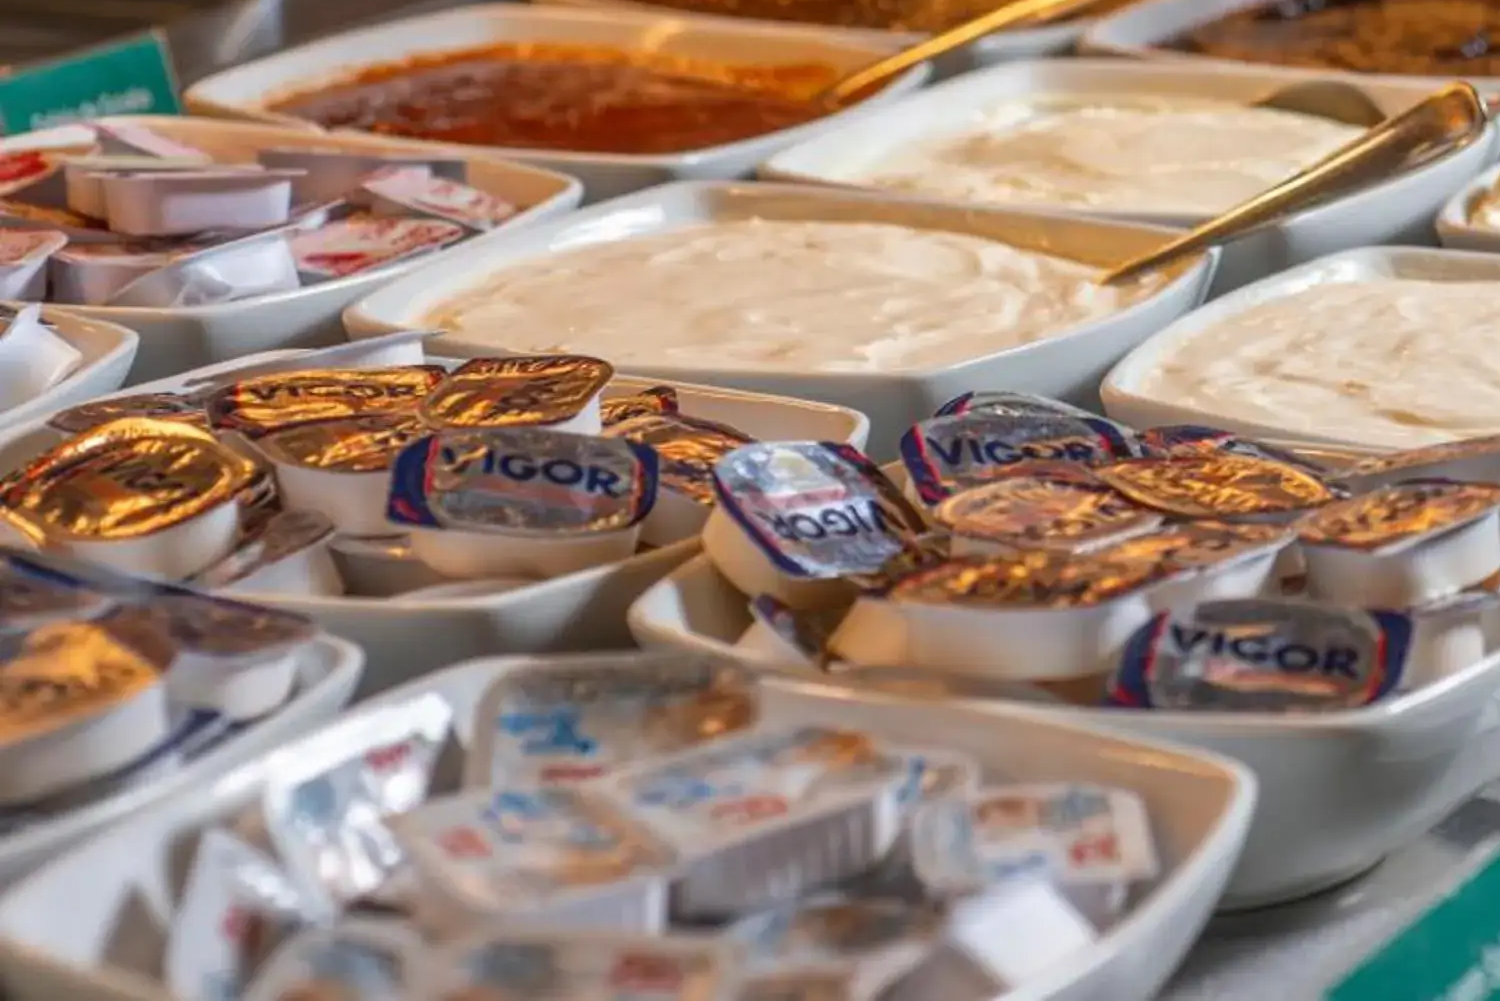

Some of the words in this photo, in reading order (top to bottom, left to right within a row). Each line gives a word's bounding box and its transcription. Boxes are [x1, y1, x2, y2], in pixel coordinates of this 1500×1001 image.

[442, 445, 622, 499] VIGOR
[925, 436, 1094, 466] VIGOR
[1170, 623, 1360, 680] VIGOR
